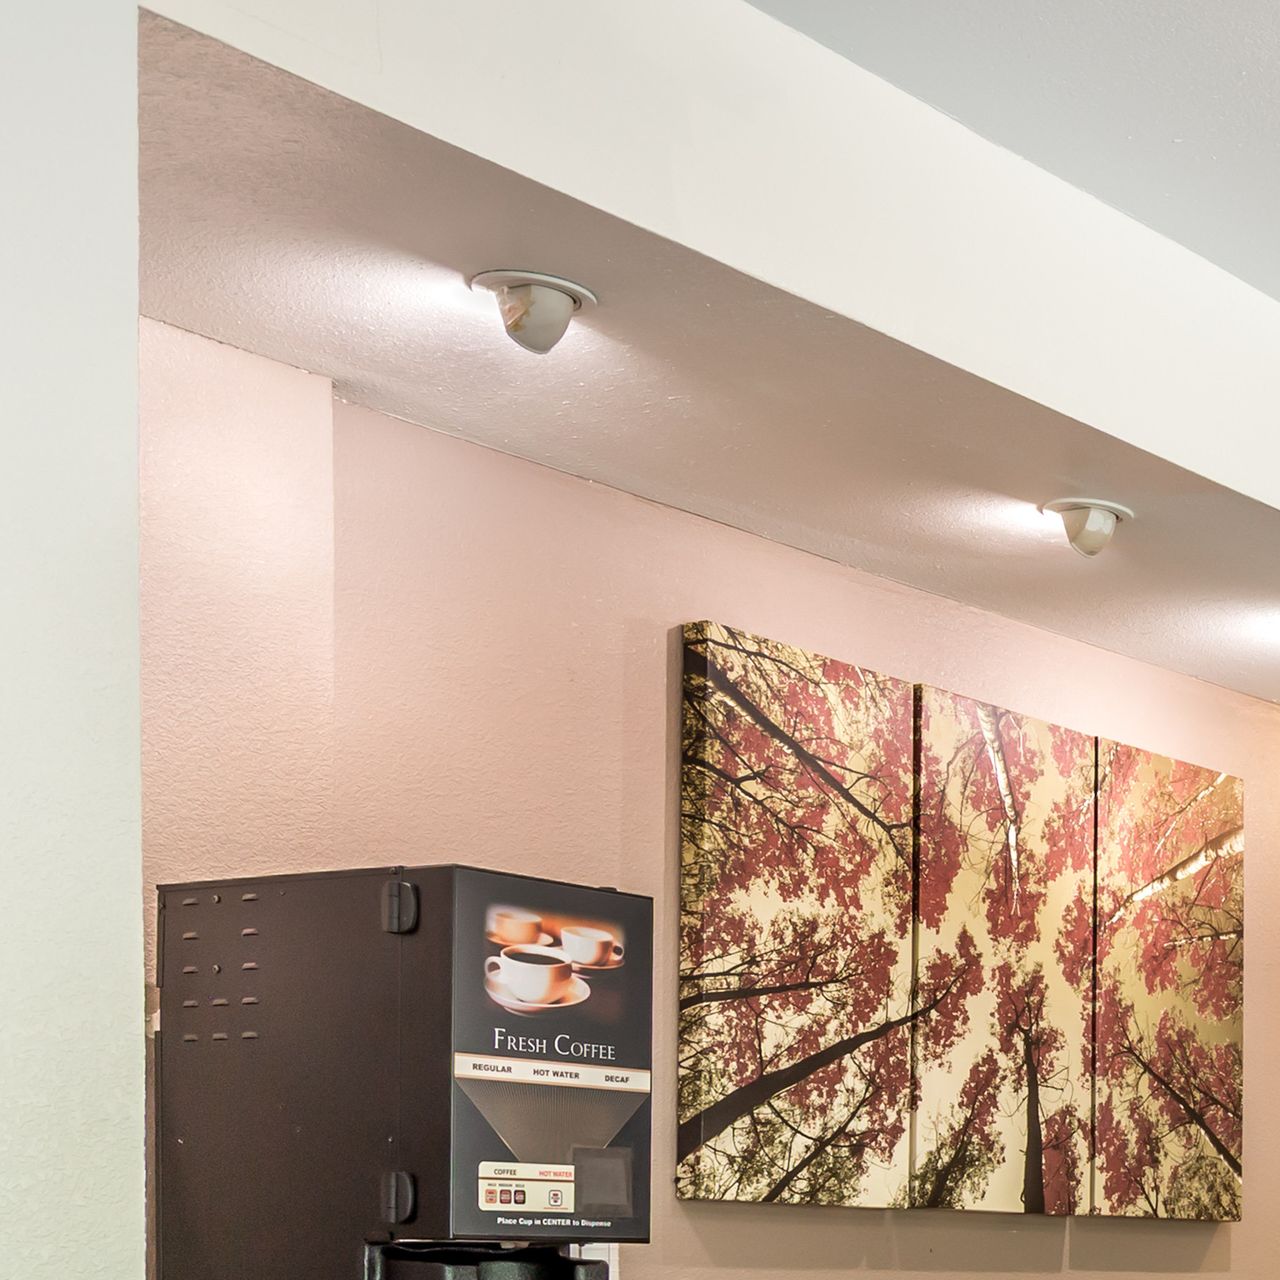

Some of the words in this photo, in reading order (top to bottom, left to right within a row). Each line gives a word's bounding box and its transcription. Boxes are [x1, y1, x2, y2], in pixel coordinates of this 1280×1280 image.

[494, 1028, 546, 1054] FRESH
[554, 1034, 616, 1060] COFFEE
[472, 1063, 512, 1074] REGULAR
[533, 1069, 550, 1077] HOT
[552, 1070, 580, 1080] WATER
[604, 1075, 630, 1084] DECAF
[493, 1168, 517, 1176] COFFEE
[497, 1217, 517, 1225] Place
[518, 1218, 533, 1226] Cup
[581, 1219, 611, 1227] Dispense
